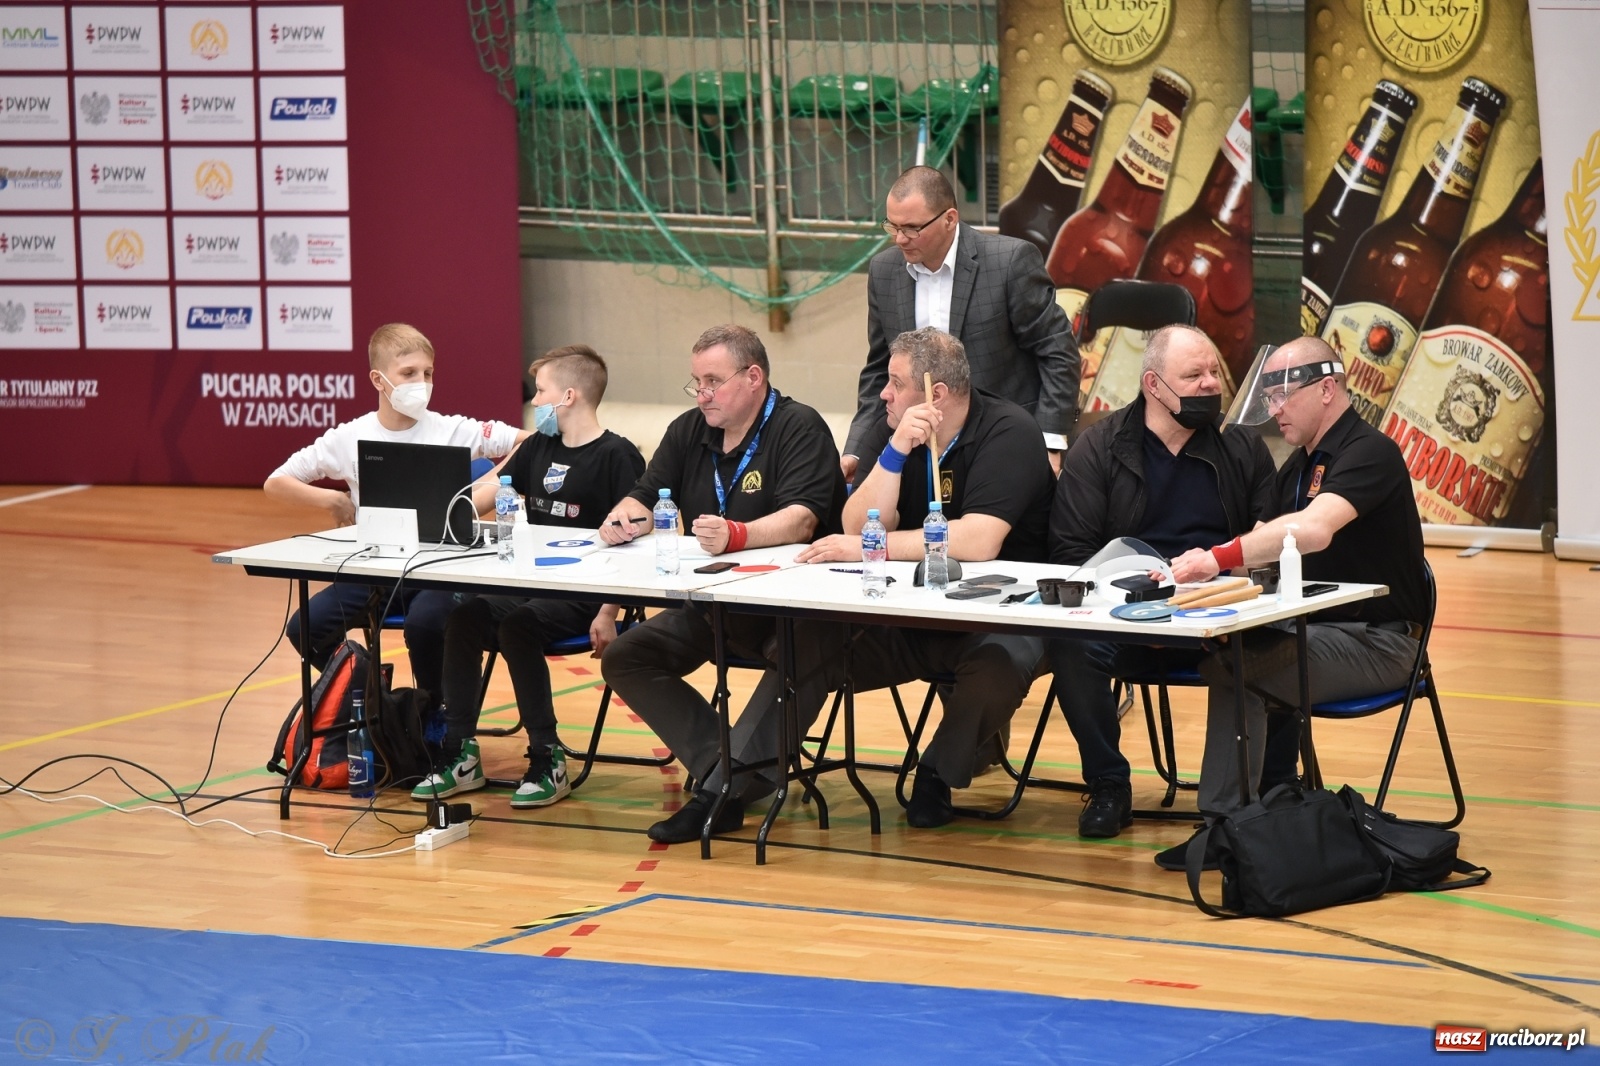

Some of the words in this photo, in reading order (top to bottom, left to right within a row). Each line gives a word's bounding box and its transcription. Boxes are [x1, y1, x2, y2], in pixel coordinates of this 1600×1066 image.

[2, 27, 59, 40] MML
[13, 179, 39, 190] Travel
[40, 179, 62, 189] Club
[1346, 356, 1385, 399] PIWO
[1442, 338, 1483, 364] BROWAR
[1484, 352, 1530, 402] ZAMKOWY
[10, 379, 75, 397] TYTULARNY
[77, 379, 98, 397] PZZ
[201, 373, 284, 398] PUCHAR
[286, 374, 355, 399] POLSKI
[221, 402, 241, 427] W
[244, 402, 336, 428] ZAPASACH
